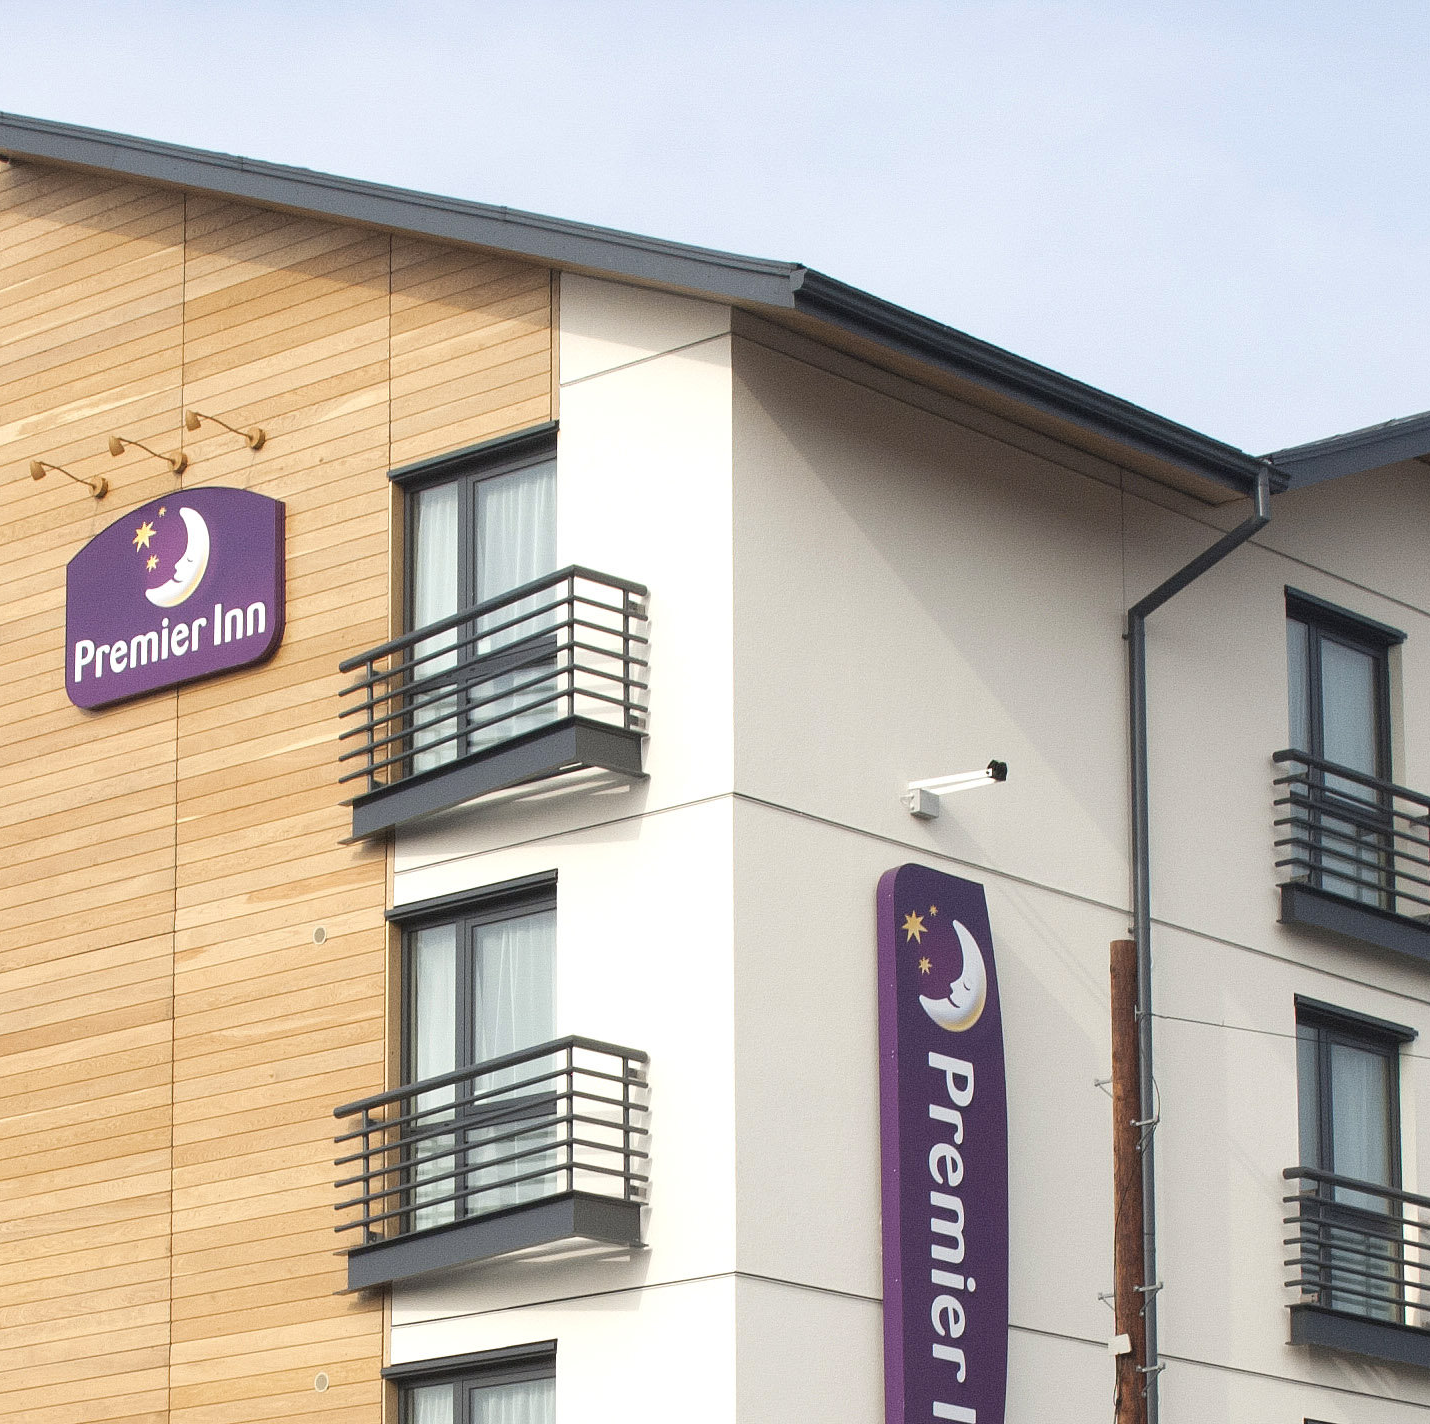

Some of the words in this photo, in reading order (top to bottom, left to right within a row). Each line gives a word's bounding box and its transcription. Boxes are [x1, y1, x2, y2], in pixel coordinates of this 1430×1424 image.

[73, 617, 207, 683] Premier
[213, 601, 266, 646] Inn
[928, 1050, 977, 1384] Premier
